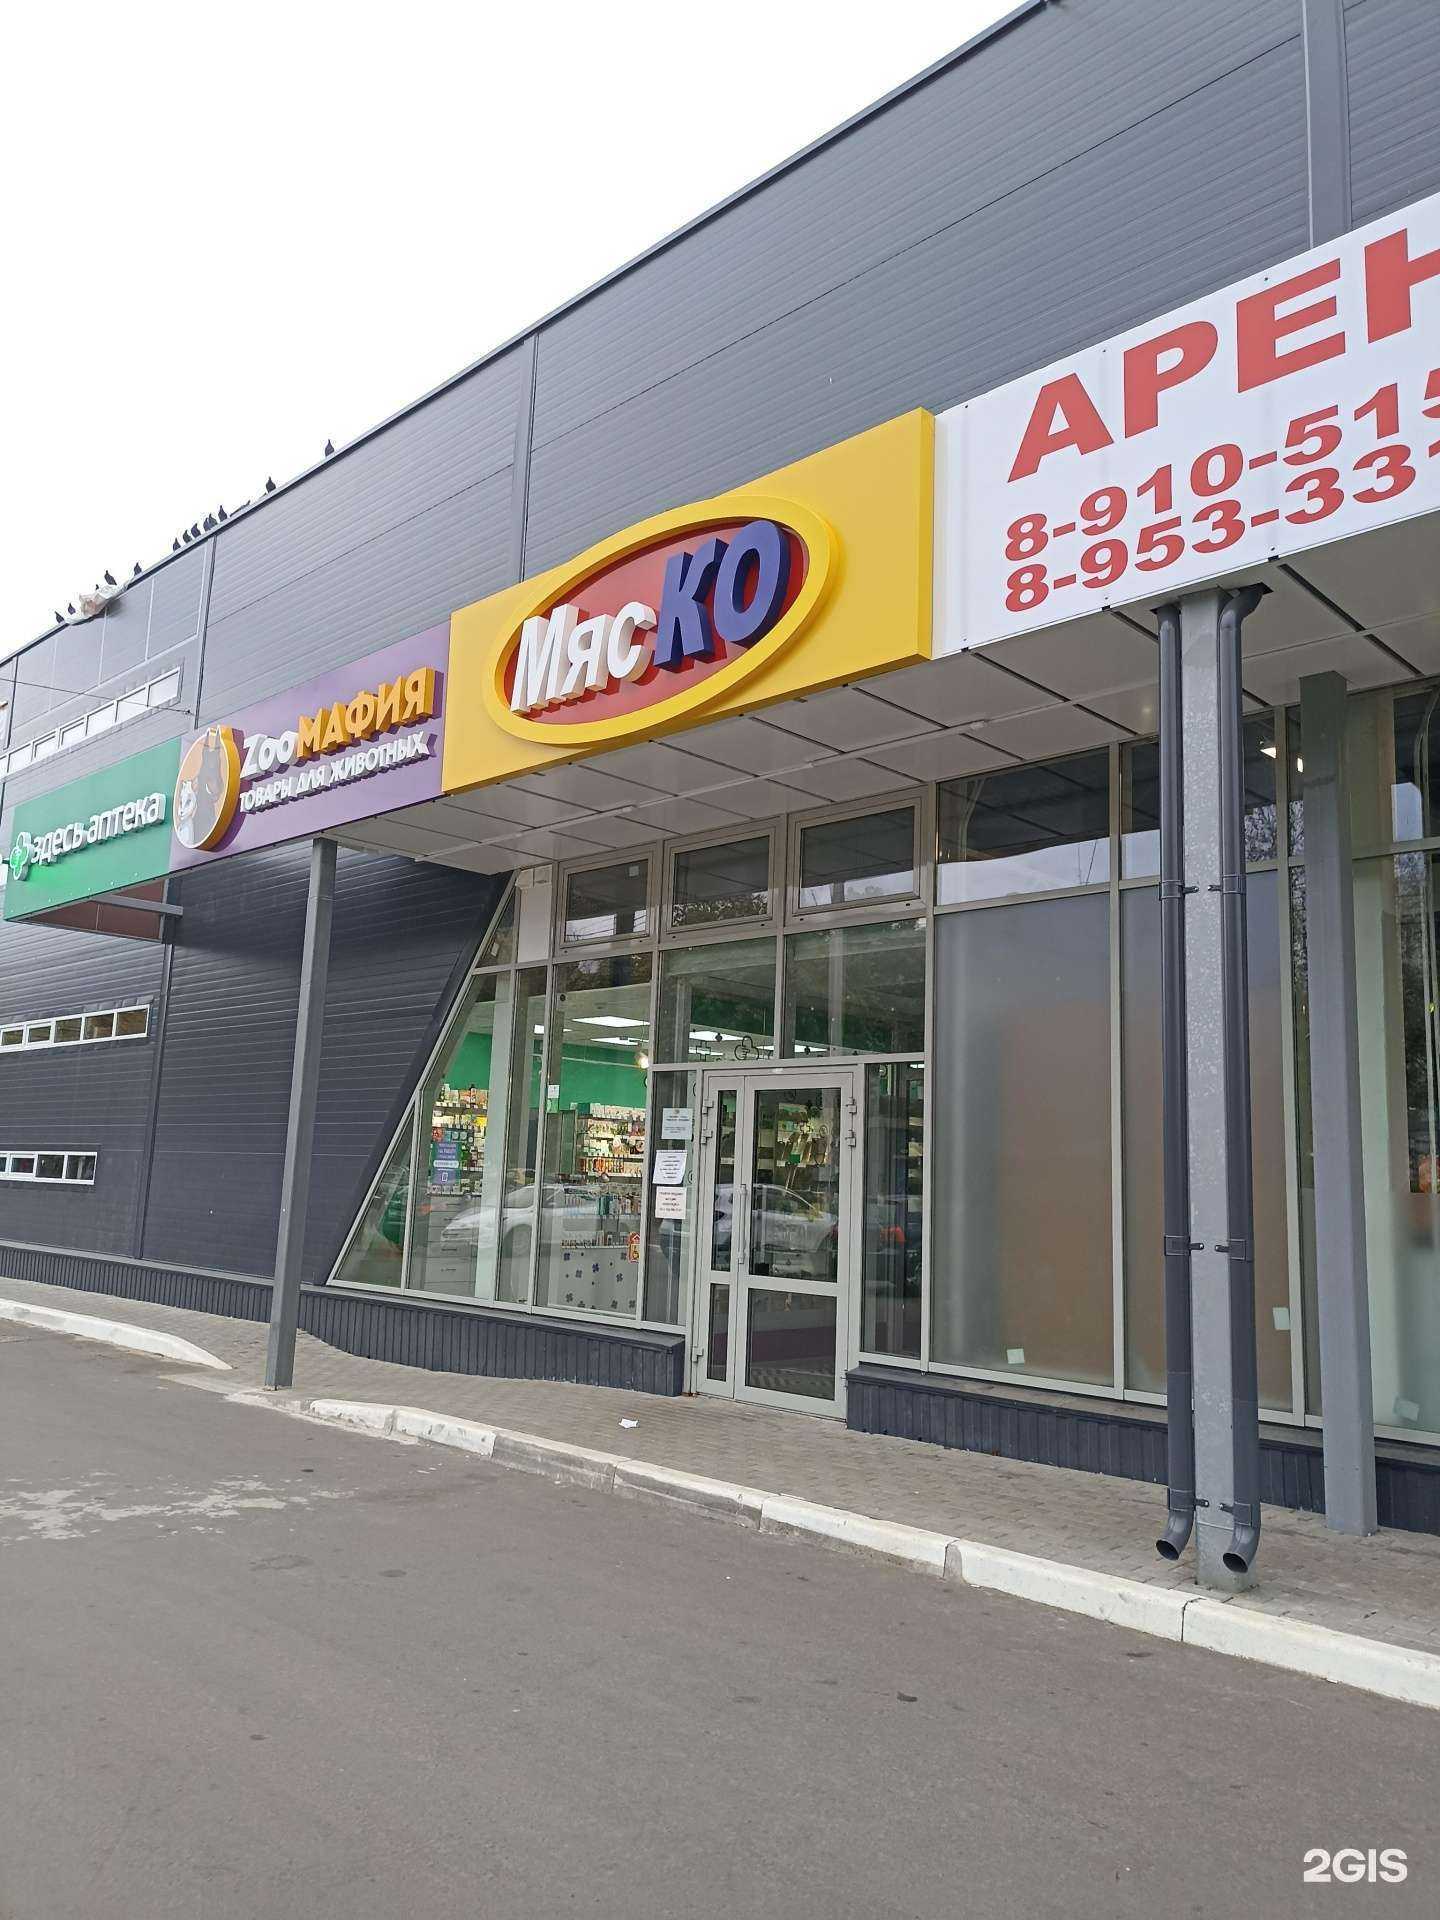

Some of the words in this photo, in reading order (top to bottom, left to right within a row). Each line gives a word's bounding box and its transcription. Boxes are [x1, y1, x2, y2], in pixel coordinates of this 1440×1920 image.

[1004, 438, 1440, 613] 8-953-33
[239, 775, 295, 813] ТОВАРЫ
[296, 764, 331, 797] ДЛЯ
[329, 730, 431, 783] ЖИВОТНЫХ
[30, 822, 88, 866] здесь
[86, 792, 167, 844] аптека
